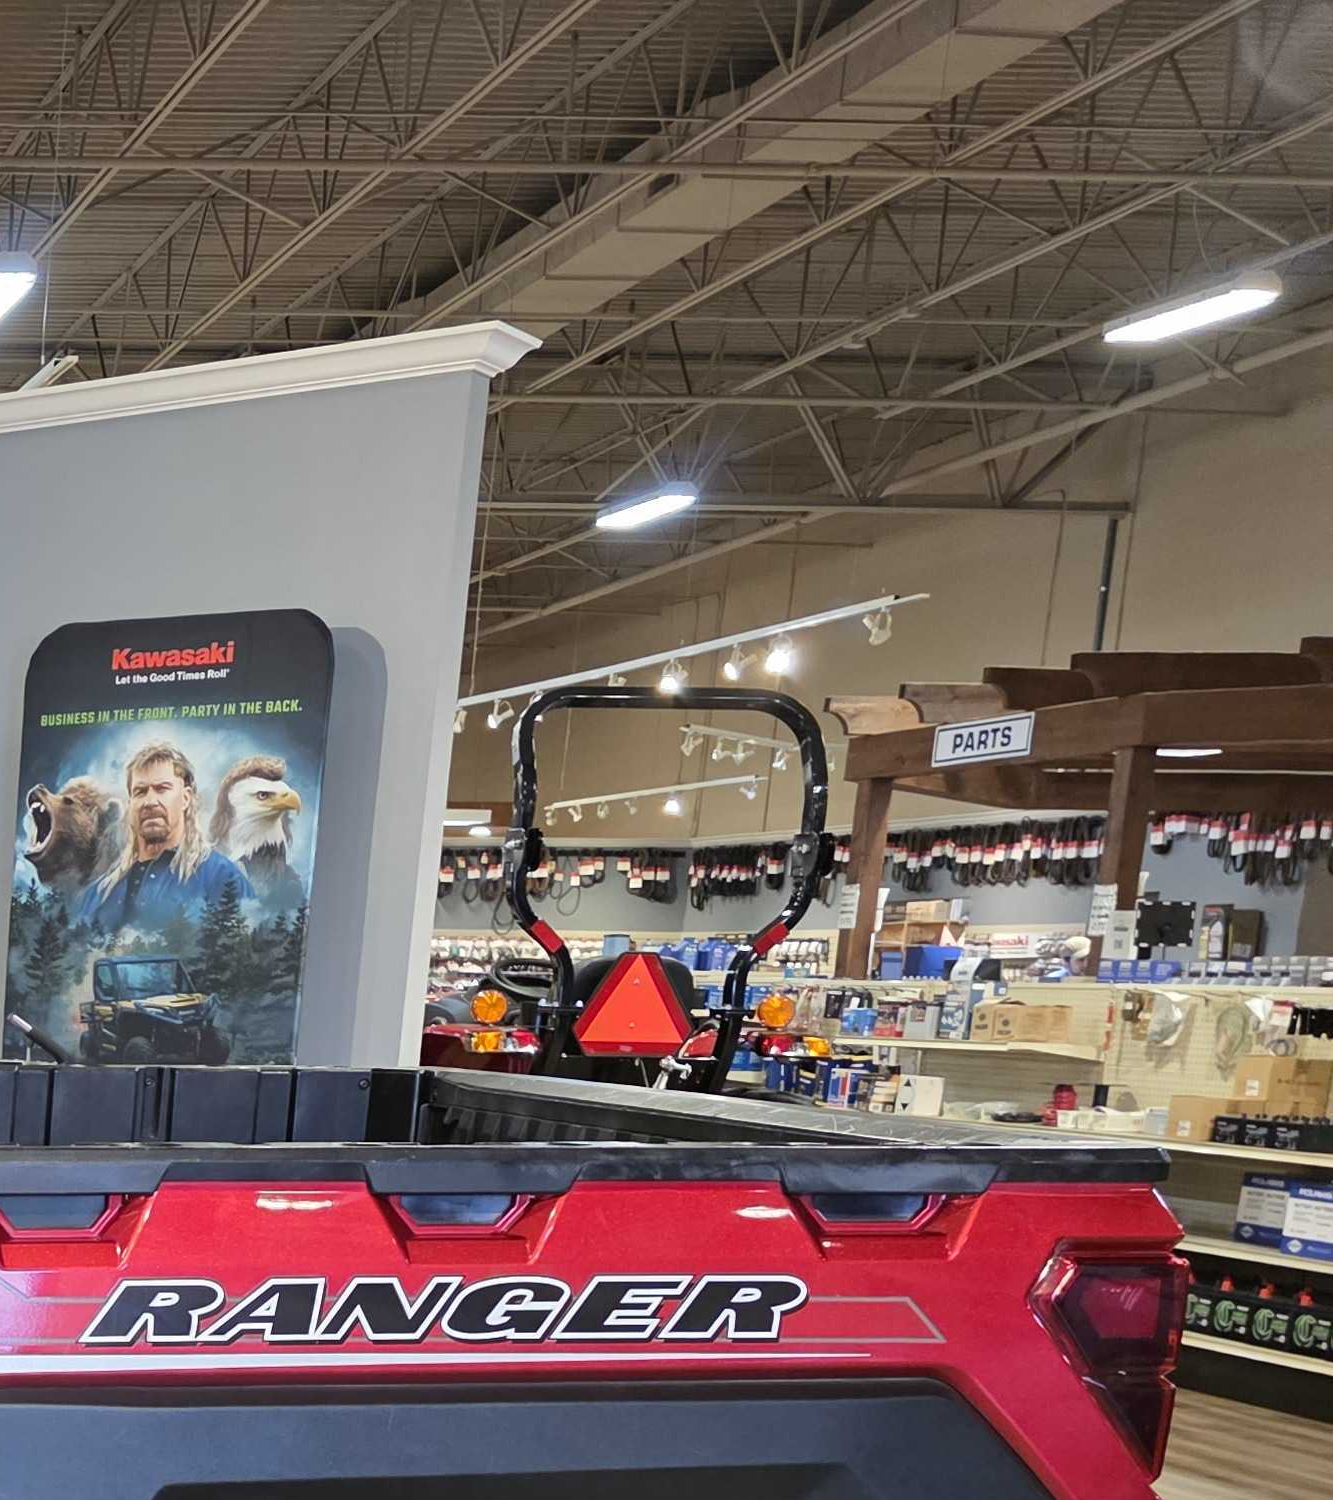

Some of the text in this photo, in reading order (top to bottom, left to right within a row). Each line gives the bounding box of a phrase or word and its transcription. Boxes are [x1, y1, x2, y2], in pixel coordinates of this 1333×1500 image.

[111, 640, 235, 670] Kawasaki
[115, 674, 130, 685] Let
[132, 673, 148, 684] the
[149, 672, 175, 682] Good
[177, 670, 205, 681] Times
[40, 699, 303, 727] BUSINESS IN THE FRONT. PARTY IN THE BACK.
[951, 726, 1012, 754] PARTS
[78, 1275, 809, 1344] RANGER
